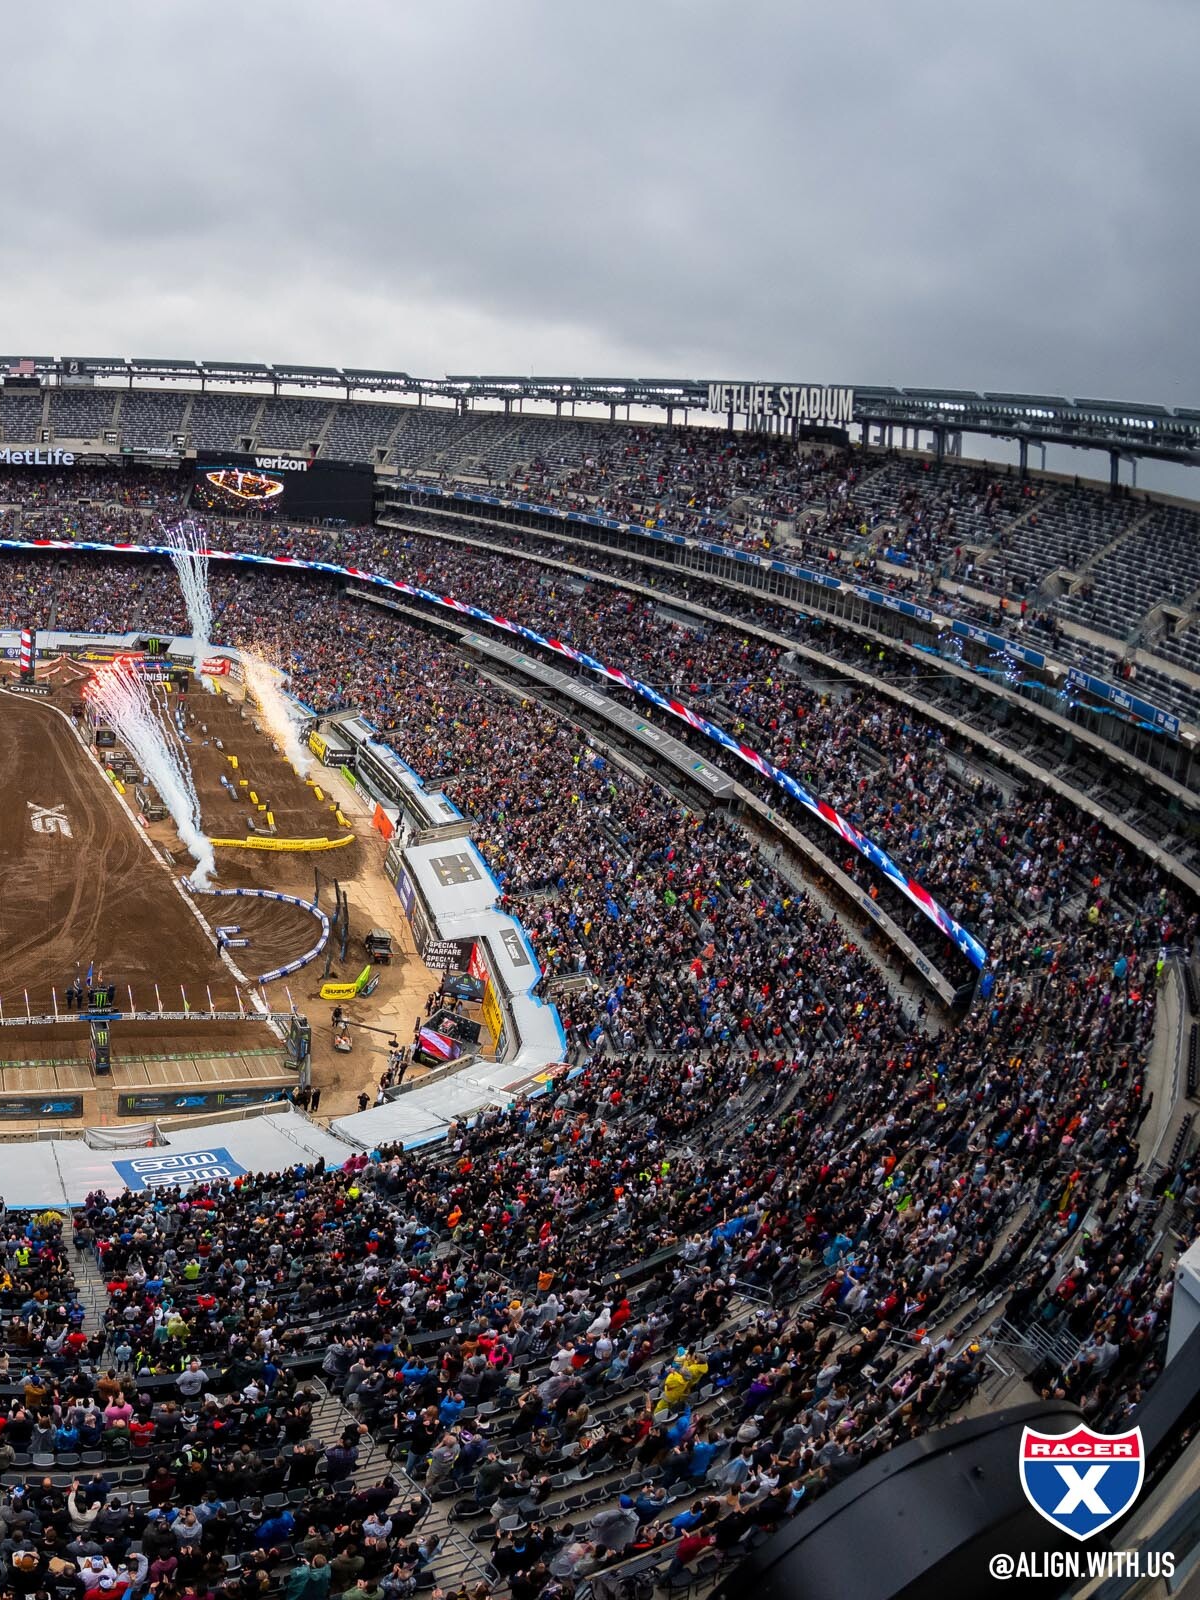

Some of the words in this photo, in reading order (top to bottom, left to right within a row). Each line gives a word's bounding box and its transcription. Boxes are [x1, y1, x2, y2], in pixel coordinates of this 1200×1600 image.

[708, 384, 773, 416] METLIFE
[779, 387, 854, 421] STADIUM
[255, 456, 308, 471] verizon
[139, 673, 169, 681] FINISH
[429, 941, 458, 949] SPECIAL
[428, 947, 461, 955] WARFARE
[425, 961, 459, 969] WARFRE
